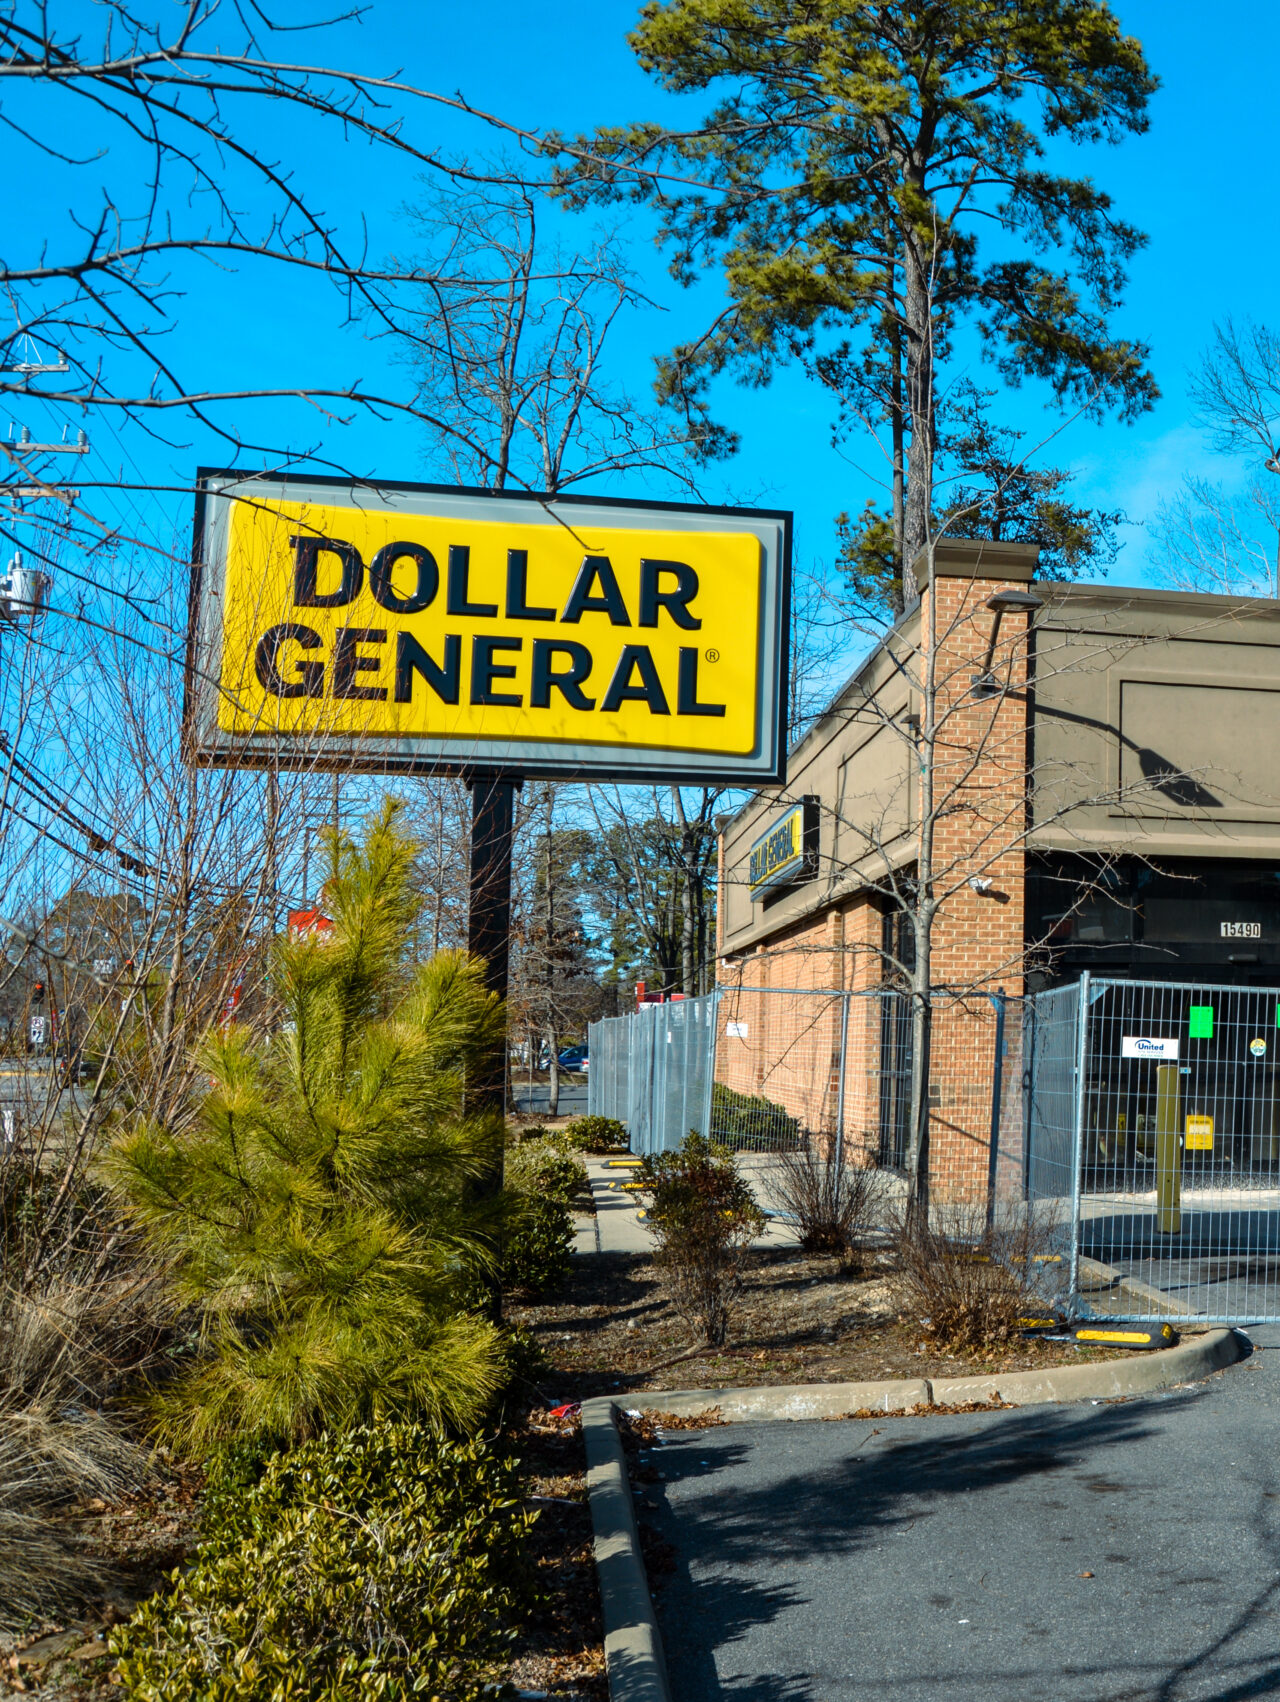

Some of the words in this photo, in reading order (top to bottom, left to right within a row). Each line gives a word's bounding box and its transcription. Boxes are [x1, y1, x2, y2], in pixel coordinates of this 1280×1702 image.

[289, 534, 703, 631] DOLLAR
[1223, 923, 1260, 937] 15490
[1138, 1043, 1164, 1051] United
